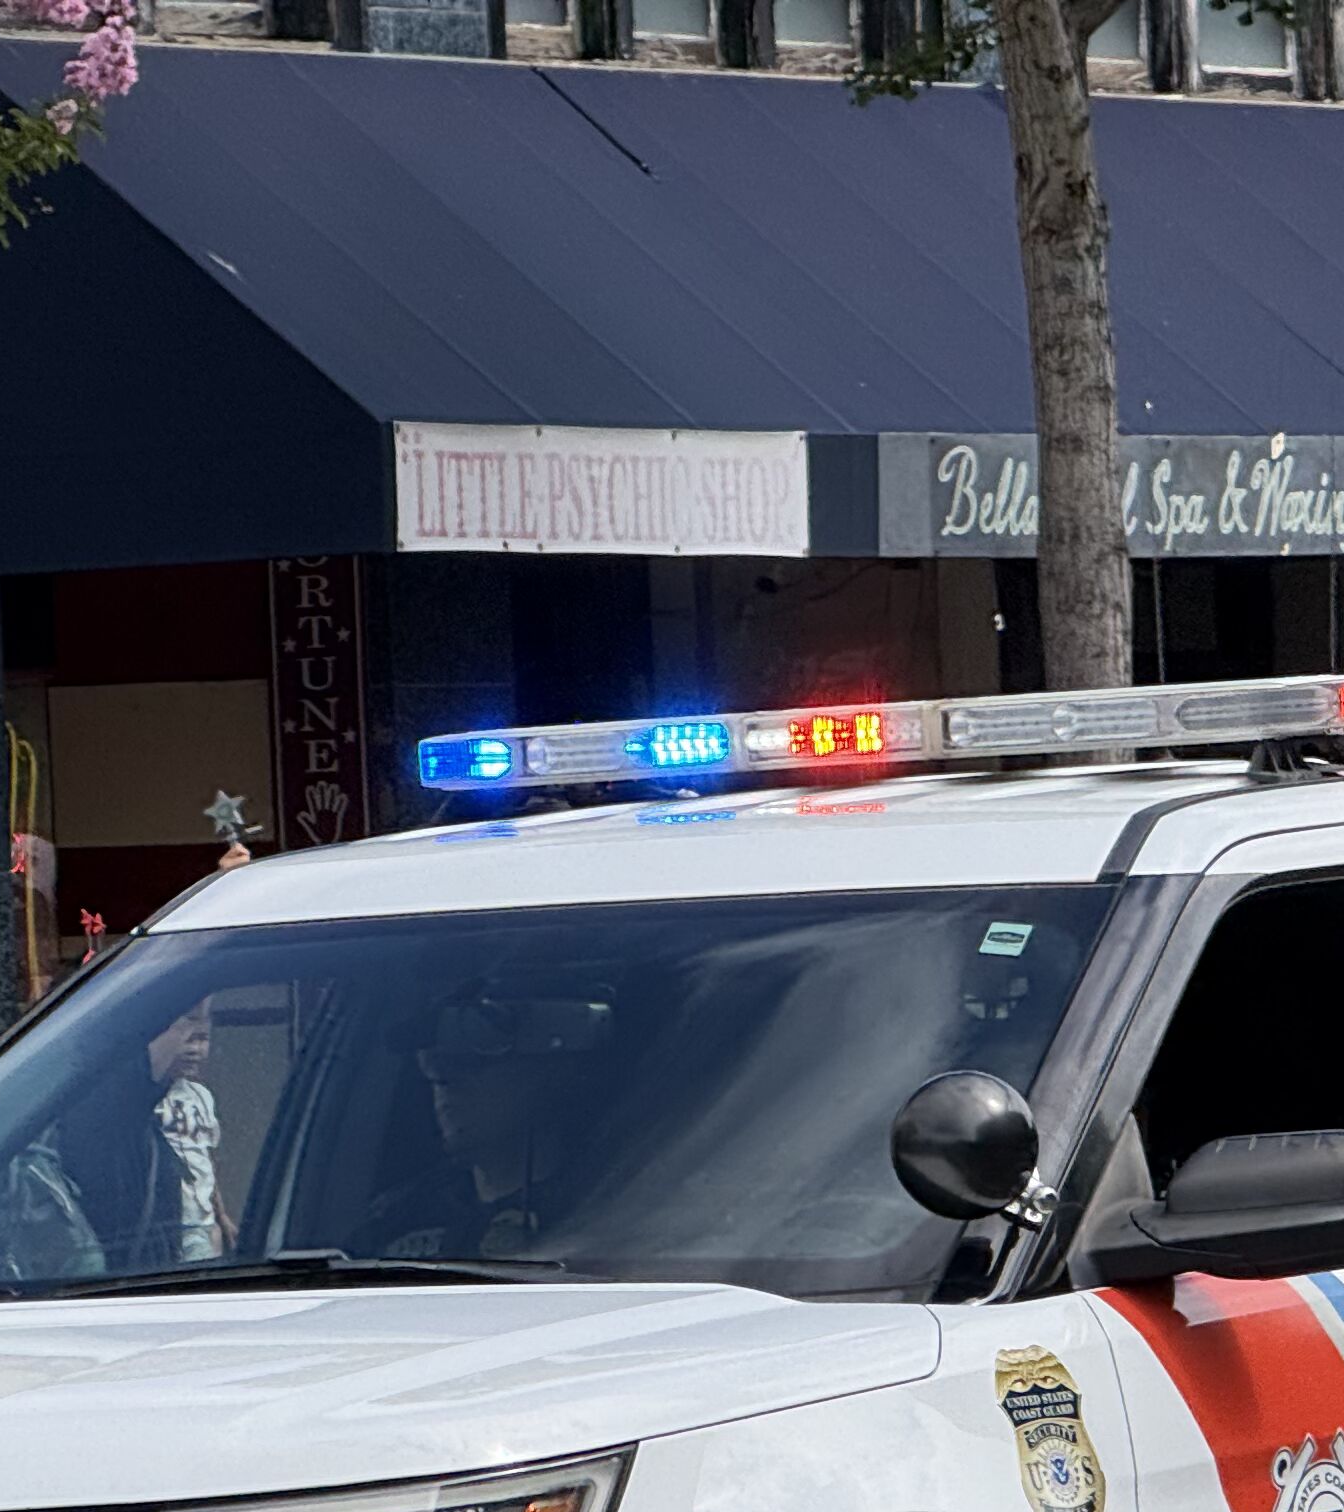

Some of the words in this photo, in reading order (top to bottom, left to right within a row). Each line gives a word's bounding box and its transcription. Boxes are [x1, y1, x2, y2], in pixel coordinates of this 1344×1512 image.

[414, 450, 537, 538] LITTLE
[544, 453, 690, 542] PSYCHIC
[703, 457, 790, 544] SHOP
[1146, 458, 1208, 552] Spa
[1219, 450, 1249, 536] &
[294, 557, 340, 774] RTUNE
[1006, 1393, 1041, 1409] UNITED
[1042, 1390, 1074, 1404] STATES
[1013, 1407, 1041, 1421] COAST
[1028, 1424, 1077, 1446] SECURITY
